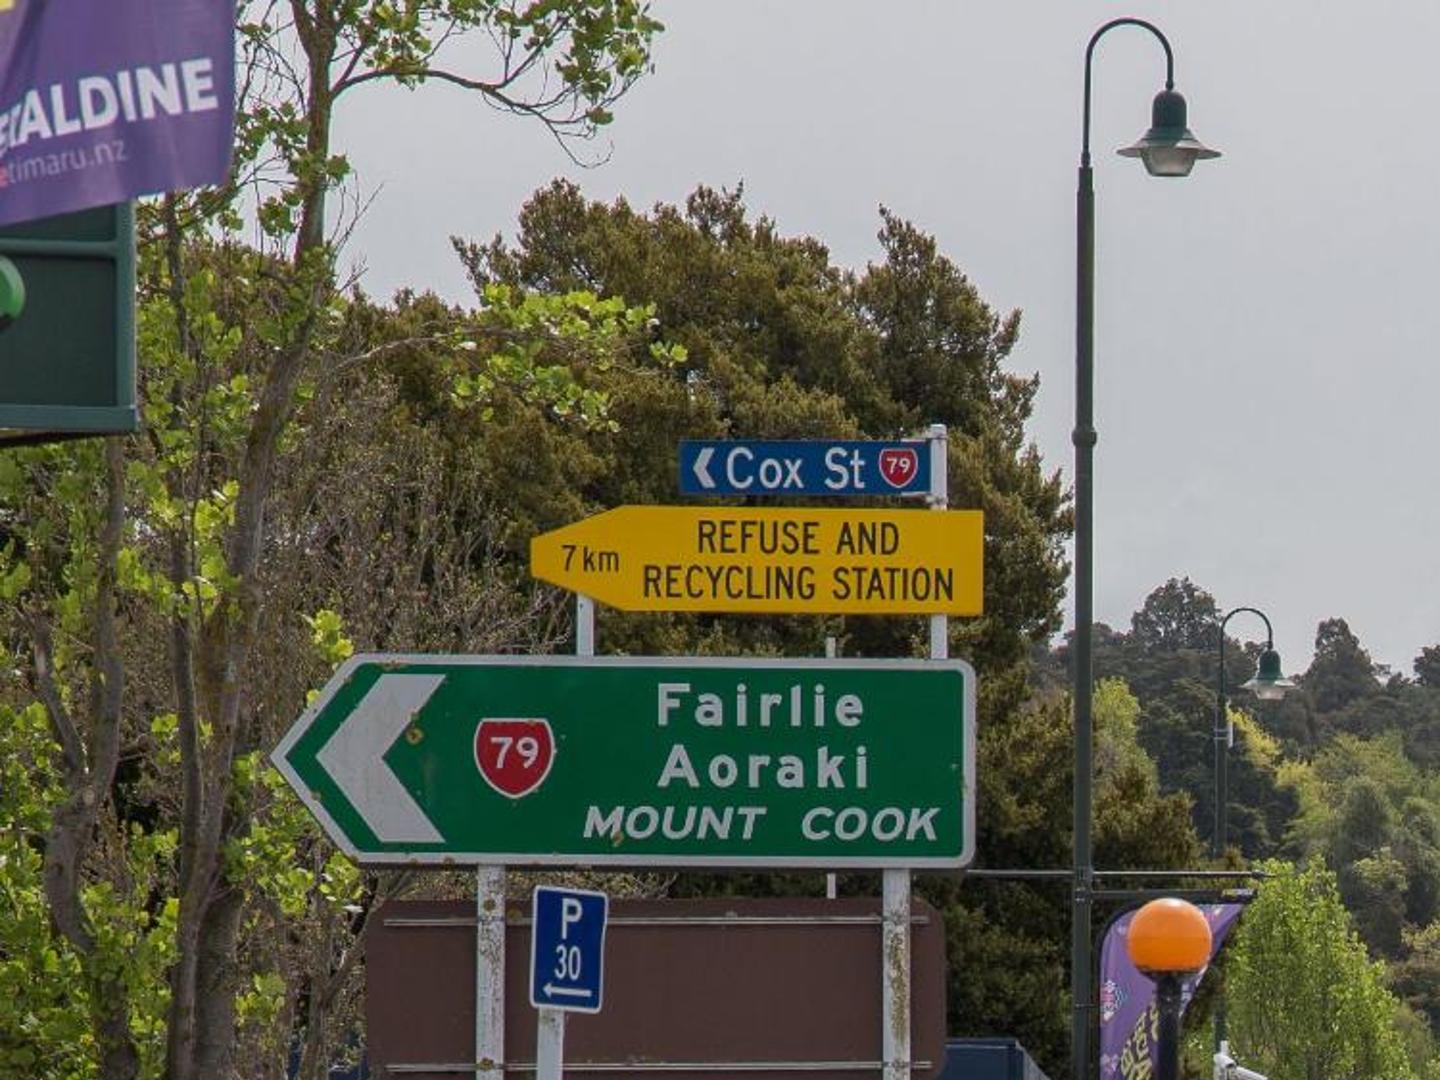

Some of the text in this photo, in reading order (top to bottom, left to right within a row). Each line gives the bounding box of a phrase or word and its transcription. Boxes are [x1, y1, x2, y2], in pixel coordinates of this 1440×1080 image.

[726, 446, 866, 489] Cox St
[886, 457, 910, 475] 79
[699, 520, 899, 555] REFUSE AND
[562, 545, 620, 572] 7 km
[643, 565, 953, 601] RECYCLING STATION
[657, 682, 864, 728] Fairlie
[490, 736, 539, 769] 79
[656, 744, 868, 789] Aoraki
[583, 805, 941, 841] MOUNT COOK
[560, 898, 583, 939] P
[554, 945, 582, 980] 30
